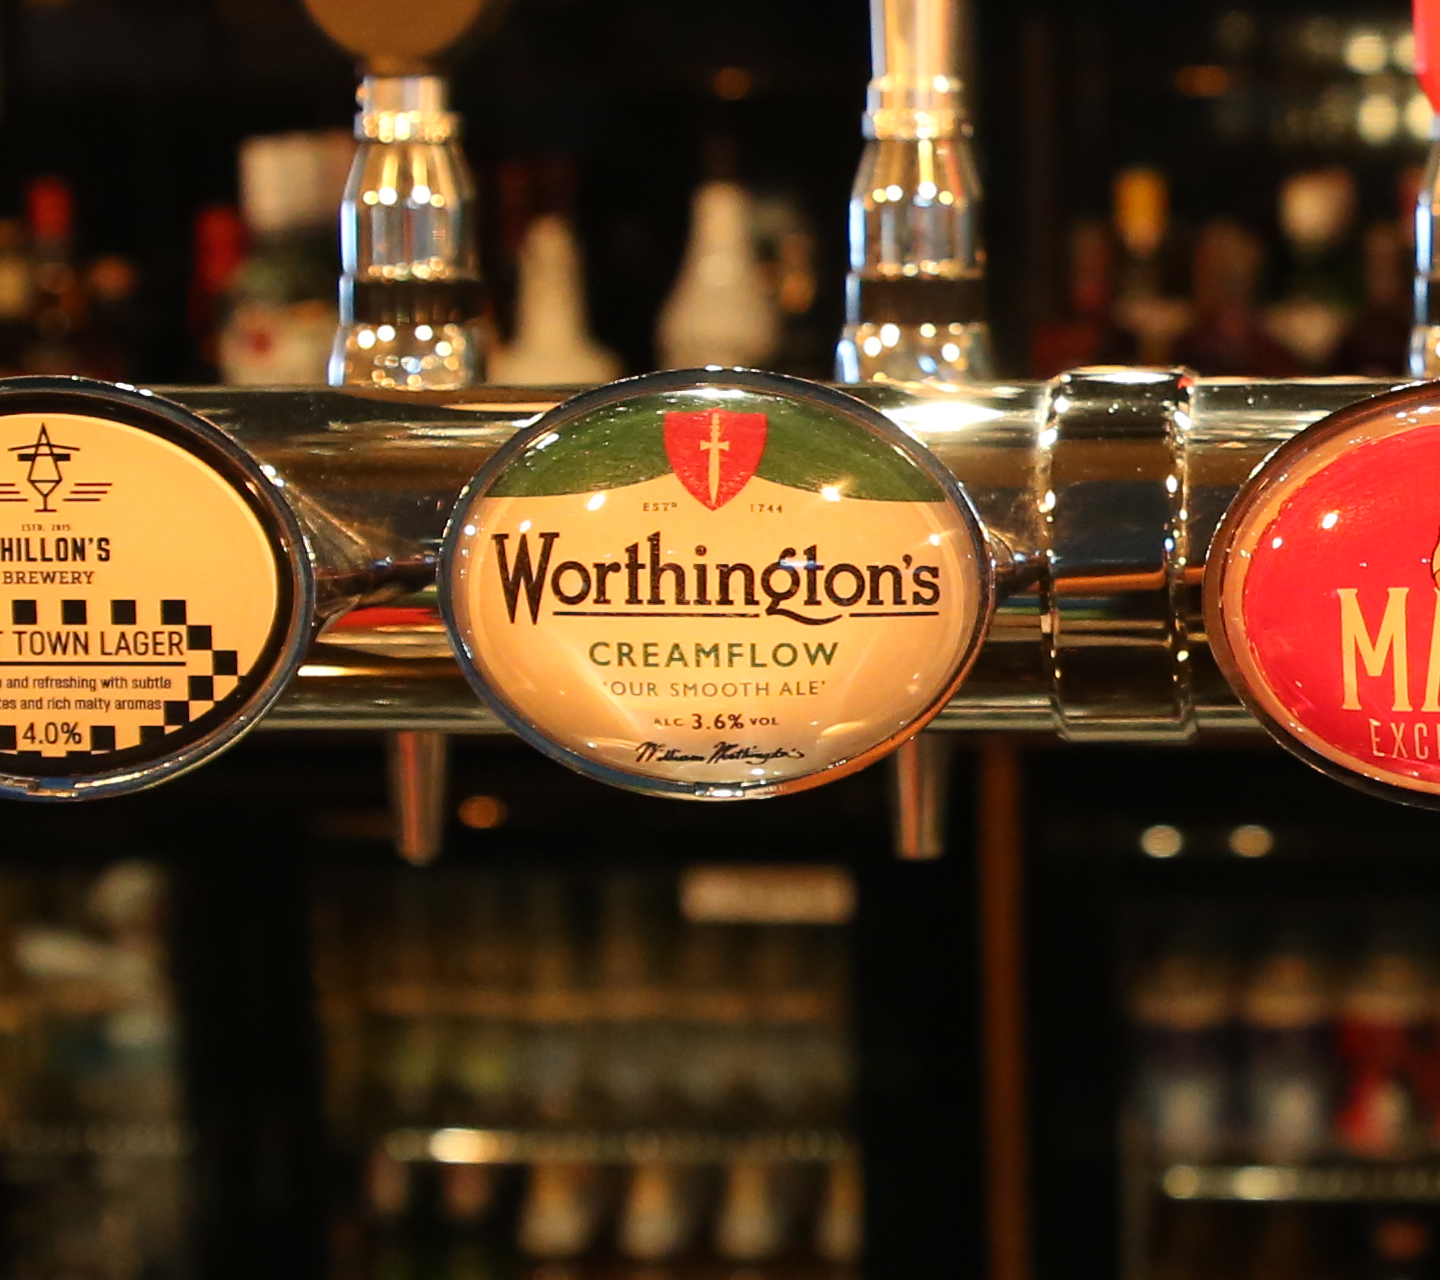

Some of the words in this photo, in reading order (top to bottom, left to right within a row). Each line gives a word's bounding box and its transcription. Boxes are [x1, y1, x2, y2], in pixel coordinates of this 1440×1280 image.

[749, 503, 784, 515] 1744
[2, 571, 95, 585] BREWERY
[491, 531, 941, 626] Worthington's
[11, 629, 90, 656] TOWN
[100, 629, 184, 656] LAGER
[589, 640, 839, 668] CREAMFLOW
[5, 675, 29, 690] and
[32, 675, 97, 692] refreshing
[99, 675, 128, 690] with
[132, 675, 172, 690] subtle
[603, 680, 659, 697] 'OUR
[669, 680, 770, 698] SMOOTH
[778, 680, 826, 697] ALE'
[20, 696, 44, 710] and
[47, 695, 71, 710] rich
[74, 695, 111, 713] malty
[114, 697, 162, 711] aromas
[653, 717, 684, 727] ALC
[691, 712, 745, 731] 3.6%
[749, 717, 779, 727] VOL
[23, 722, 83, 745] 4.0%
